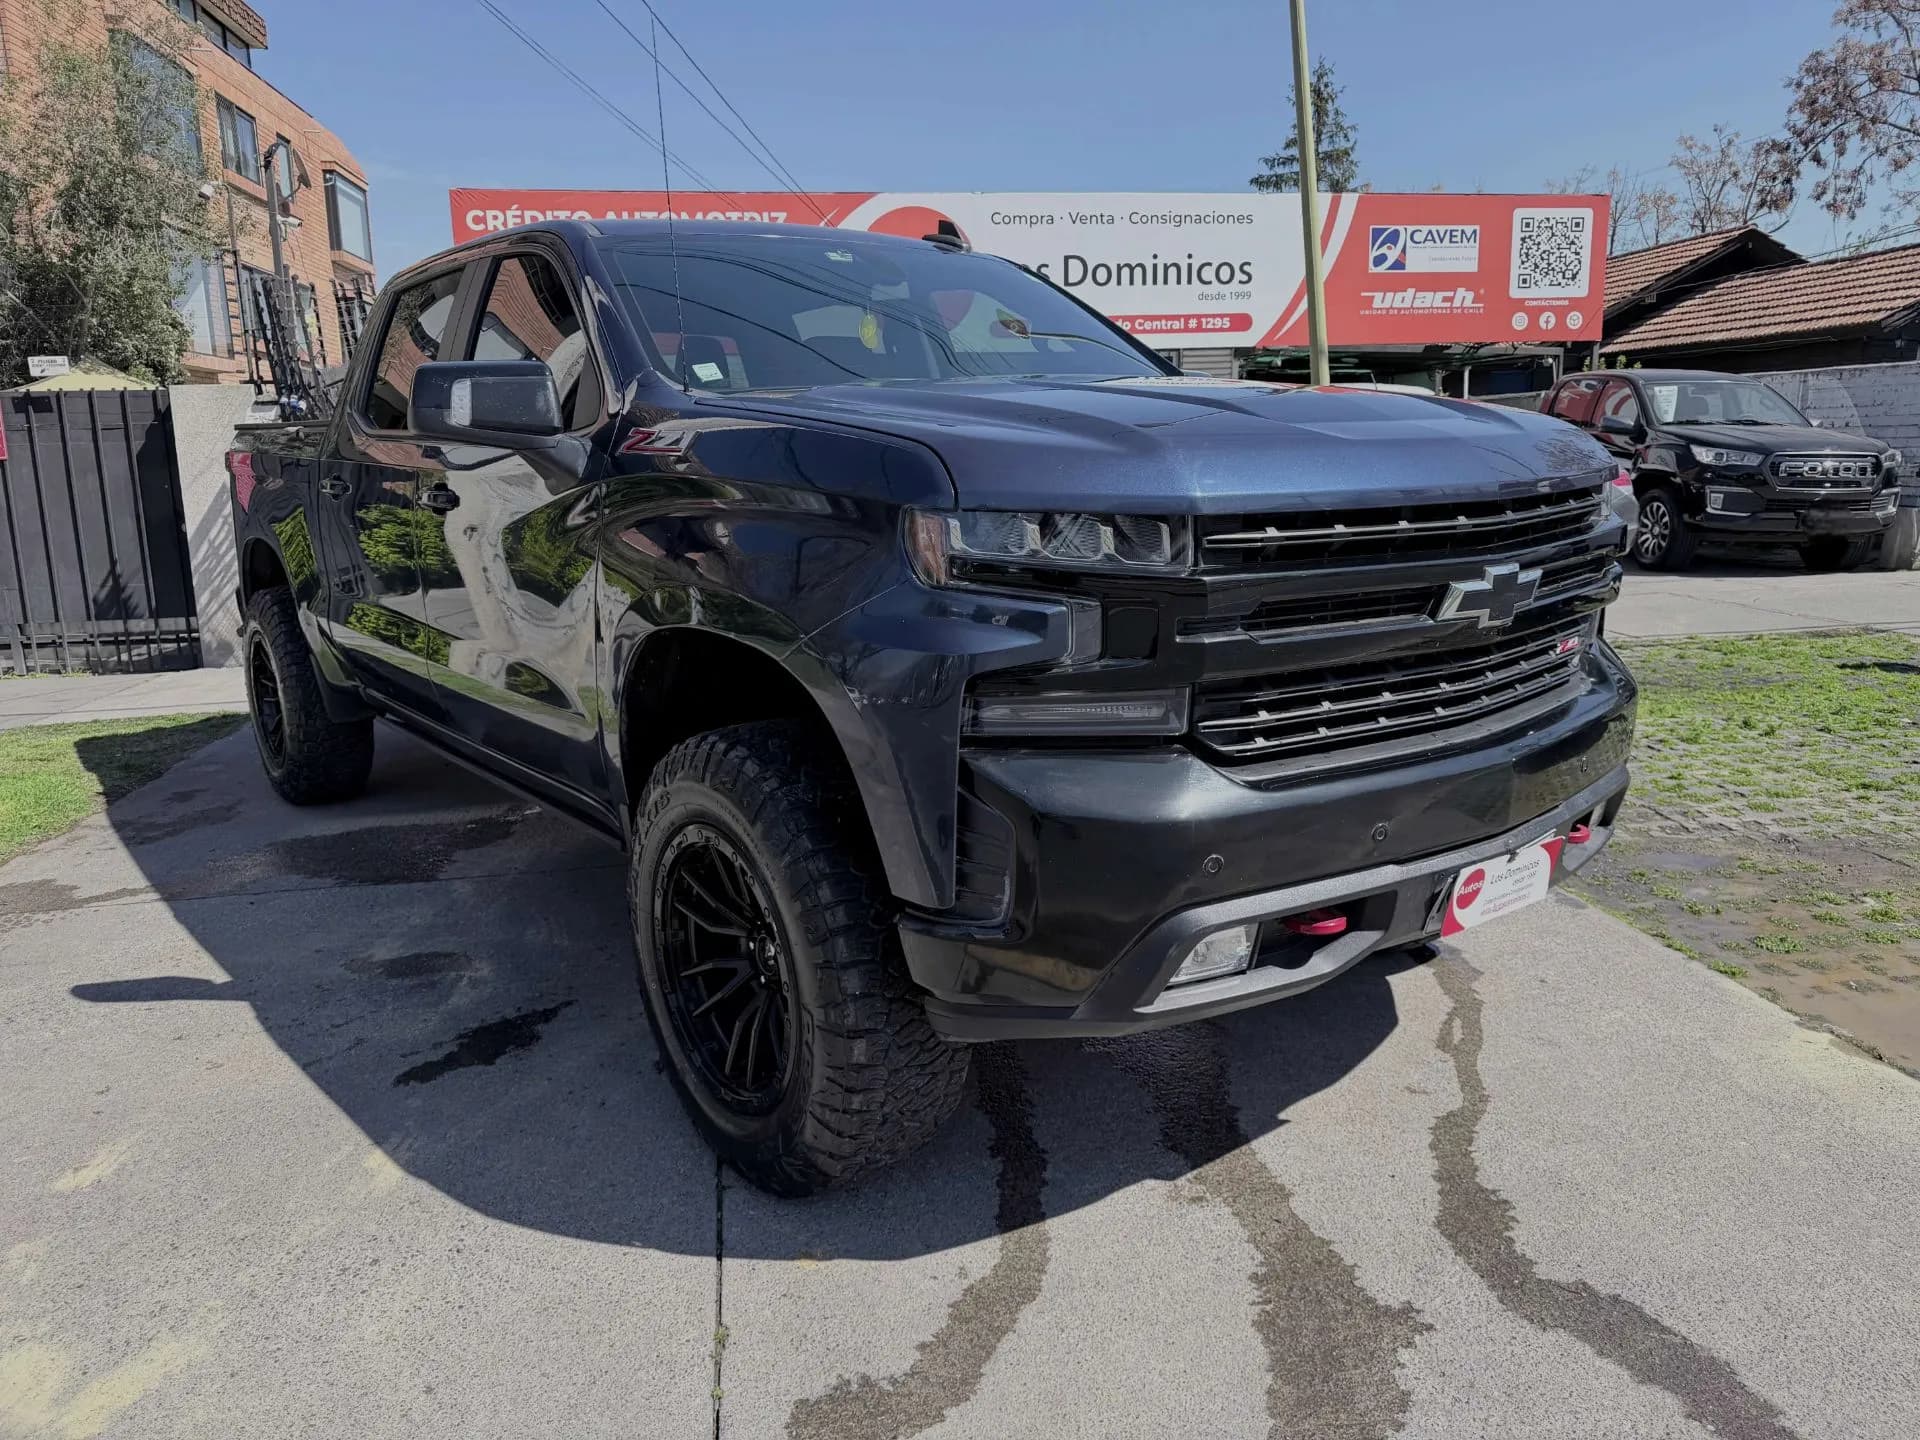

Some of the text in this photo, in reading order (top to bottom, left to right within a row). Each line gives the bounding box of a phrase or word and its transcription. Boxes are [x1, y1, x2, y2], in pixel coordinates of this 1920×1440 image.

[990, 211, 1254, 228] Compra Venta Consignaciones
[1409, 229, 1478, 244] CAVEM
[1063, 253, 1253, 287] Dominicos
[1197, 291, 1252, 301] desde 1999
[1361, 287, 1485, 308] udach
[1134, 317, 1185, 330] Central
[1187, 318, 1198, 329] #
[1201, 317, 1231, 329] 1295
[1457, 880, 1485, 897] Autos
